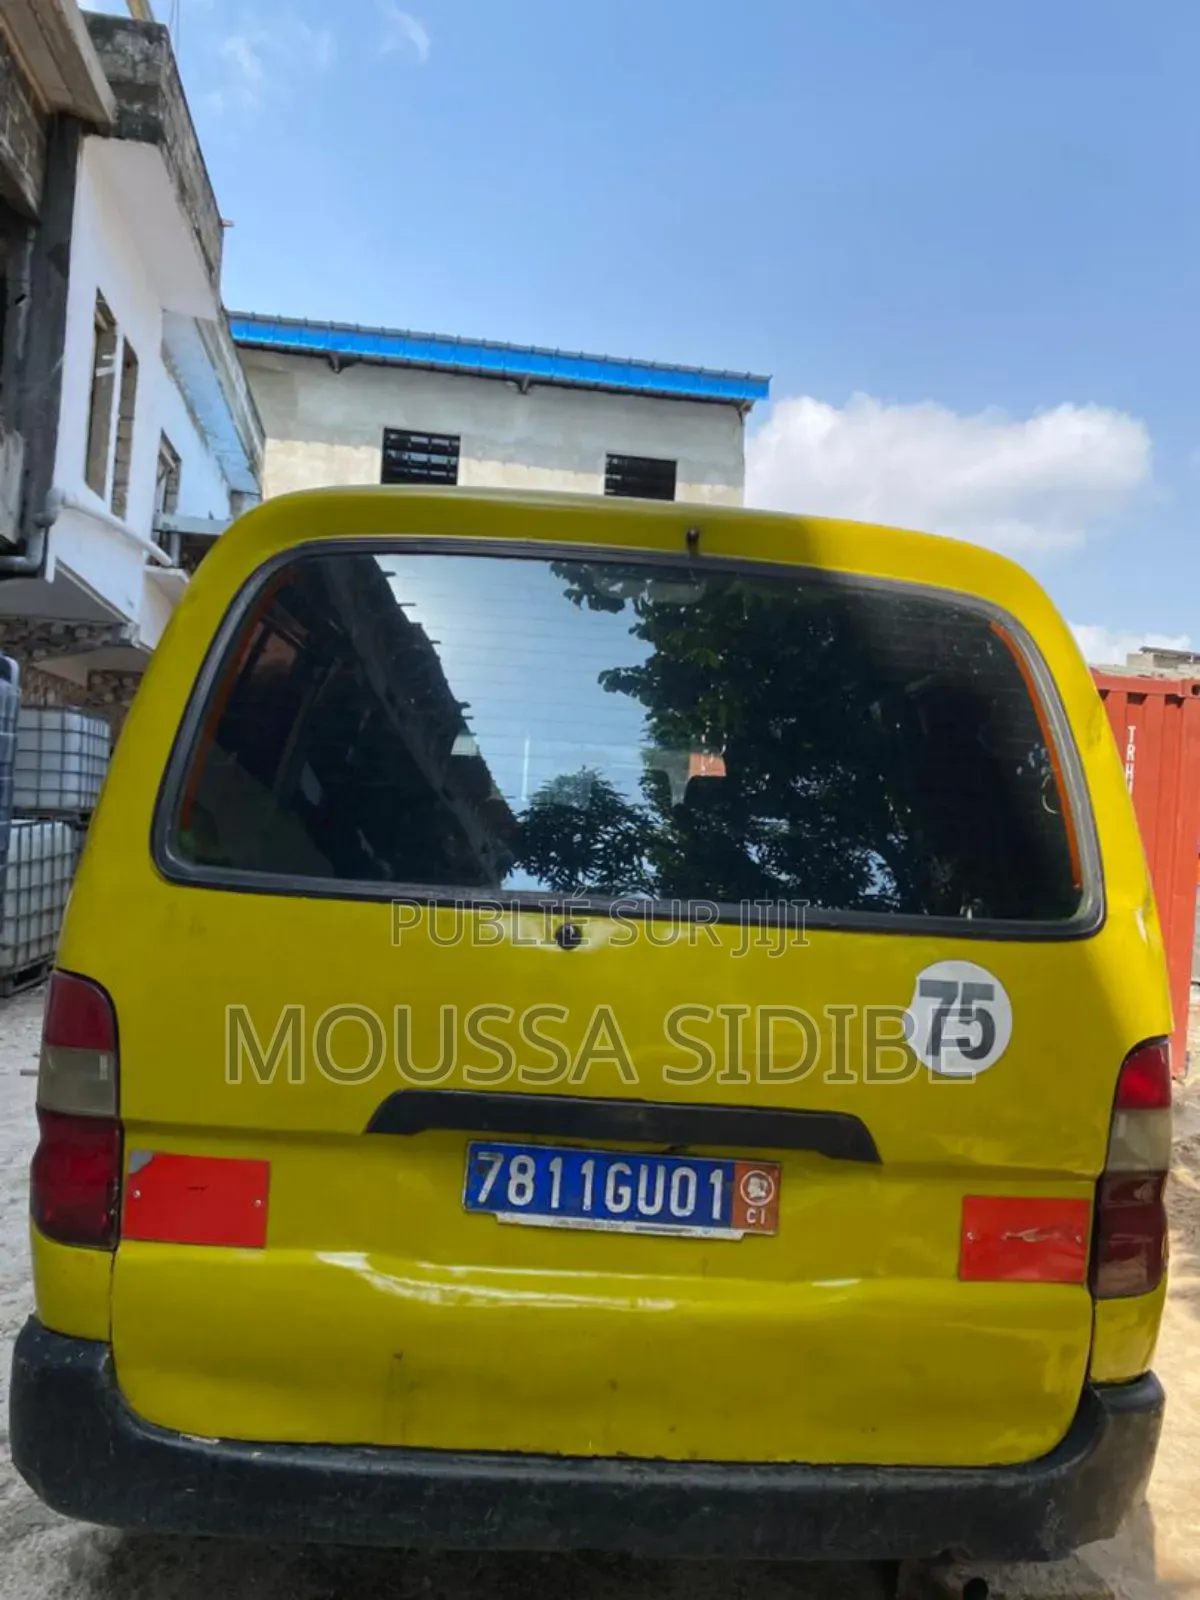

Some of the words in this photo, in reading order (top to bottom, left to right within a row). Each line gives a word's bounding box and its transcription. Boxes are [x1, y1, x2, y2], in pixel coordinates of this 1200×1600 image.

[918, 978, 996, 1060] 75
[477, 1152, 724, 1220] 7811GU01
[746, 1210, 766, 1225] CI
